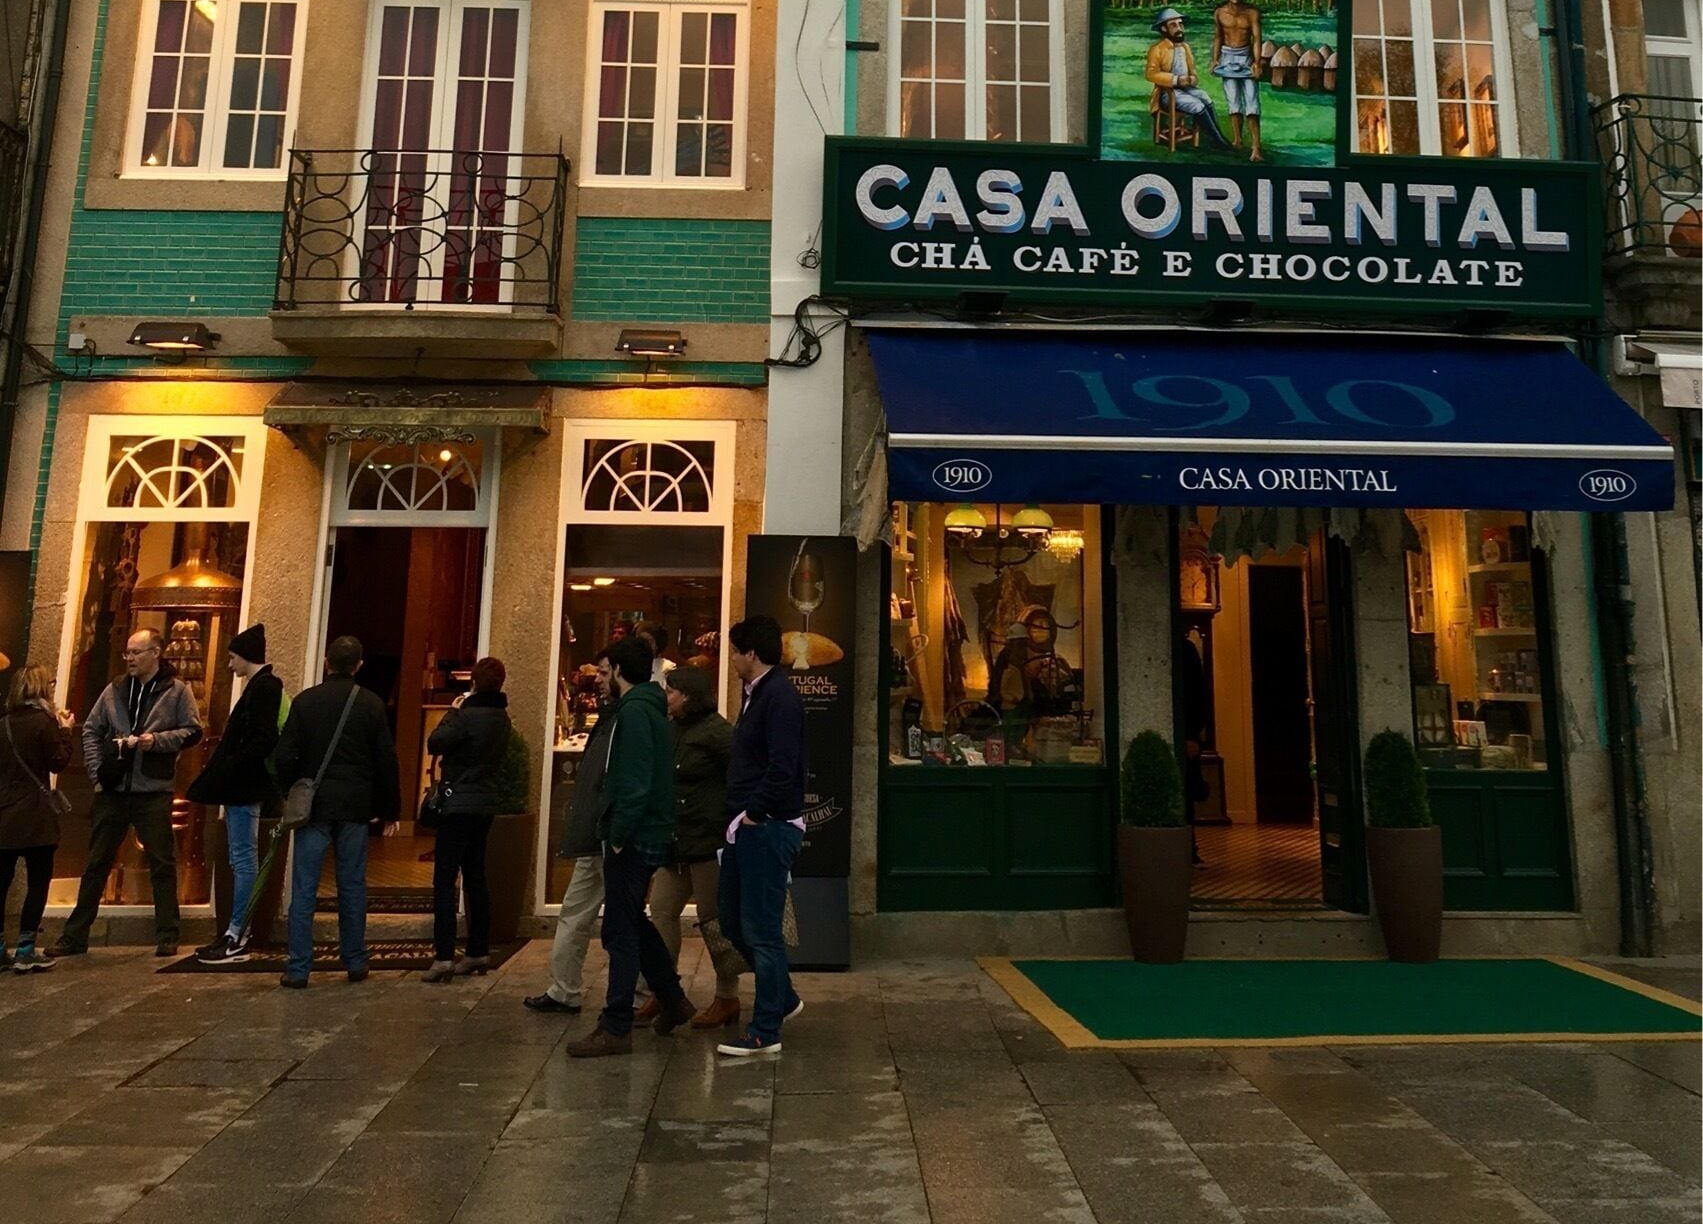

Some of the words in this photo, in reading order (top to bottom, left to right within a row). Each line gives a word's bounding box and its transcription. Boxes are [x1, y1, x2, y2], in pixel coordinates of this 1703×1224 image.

[856, 164, 1091, 236] CASA
[1121, 173, 1570, 252] ORIENTAL
[890, 236, 991, 270] CHÁ
[1013, 241, 1139, 275] CAFÉ
[1163, 250, 1192, 277] E
[1215, 253, 1524, 287] CHOCOLATE
[1057, 369, 1456, 431] 1910
[943, 466, 982, 487] 1910
[1179, 466, 1252, 491] CASA
[1258, 468, 1397, 493] ORIENTAL
[1589, 476, 1627, 496] 1910
[788, 676, 832, 685] TUGAL
[796, 685, 838, 695] IENCE
